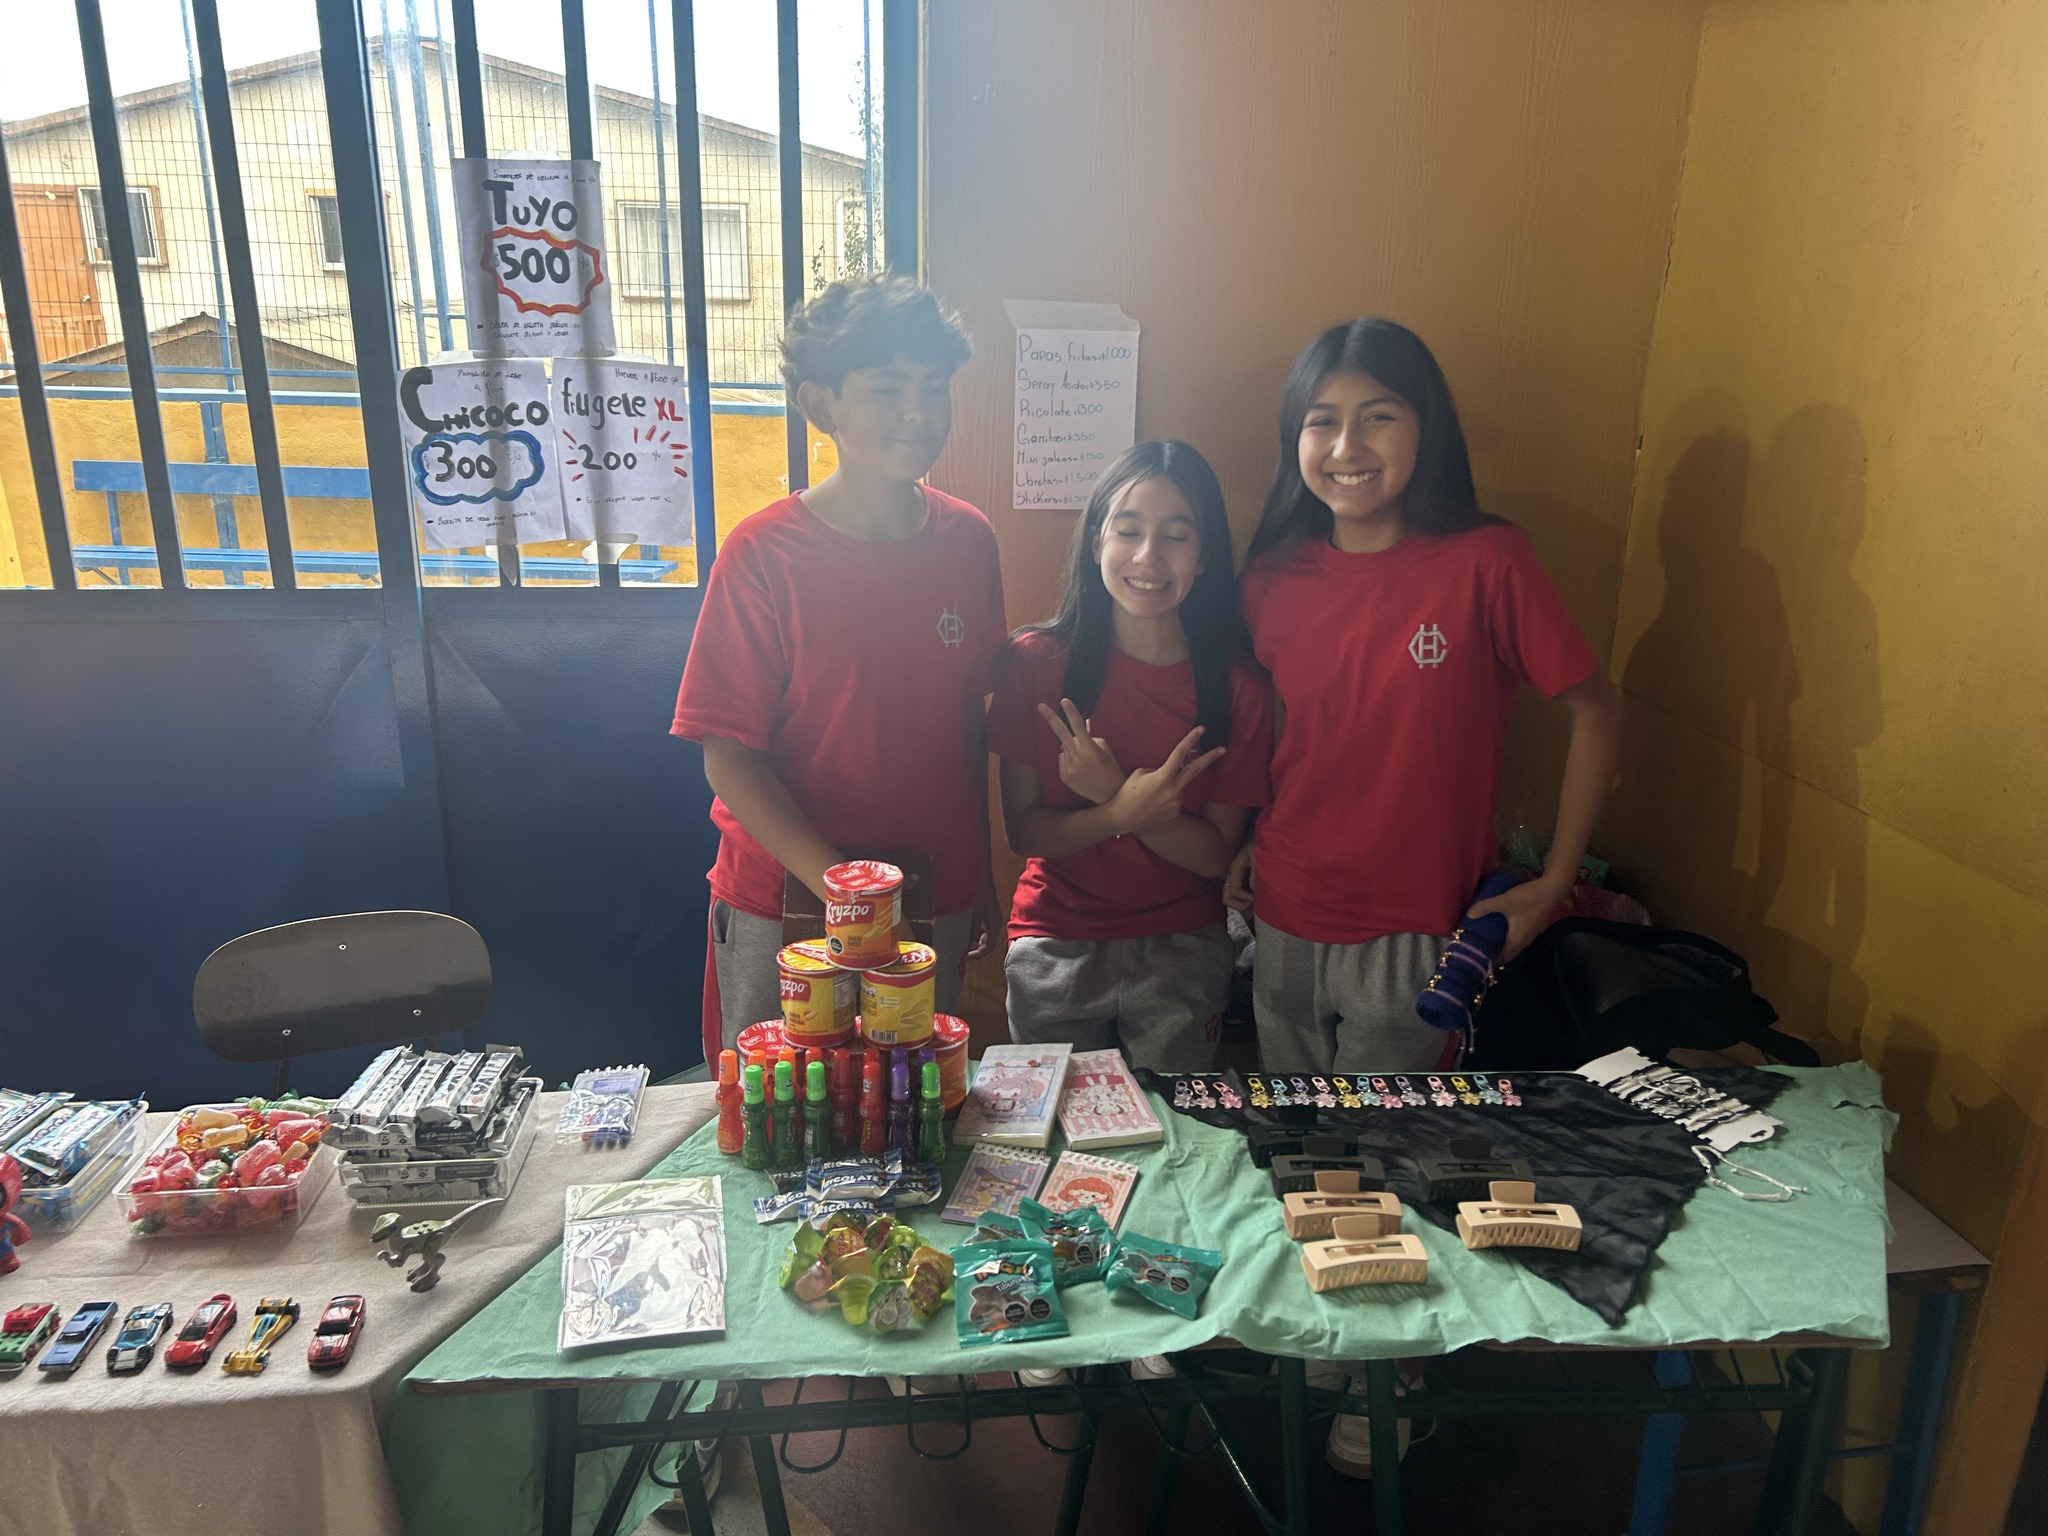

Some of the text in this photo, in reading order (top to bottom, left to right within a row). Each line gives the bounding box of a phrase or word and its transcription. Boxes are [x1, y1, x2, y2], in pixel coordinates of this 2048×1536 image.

[1019, 335, 1062, 362] Papas
[1018, 369, 1055, 396] Spray
[653, 396, 684, 421] XL
[578, 444, 637, 470] 200
[826, 899, 870, 925] Kryzpo
